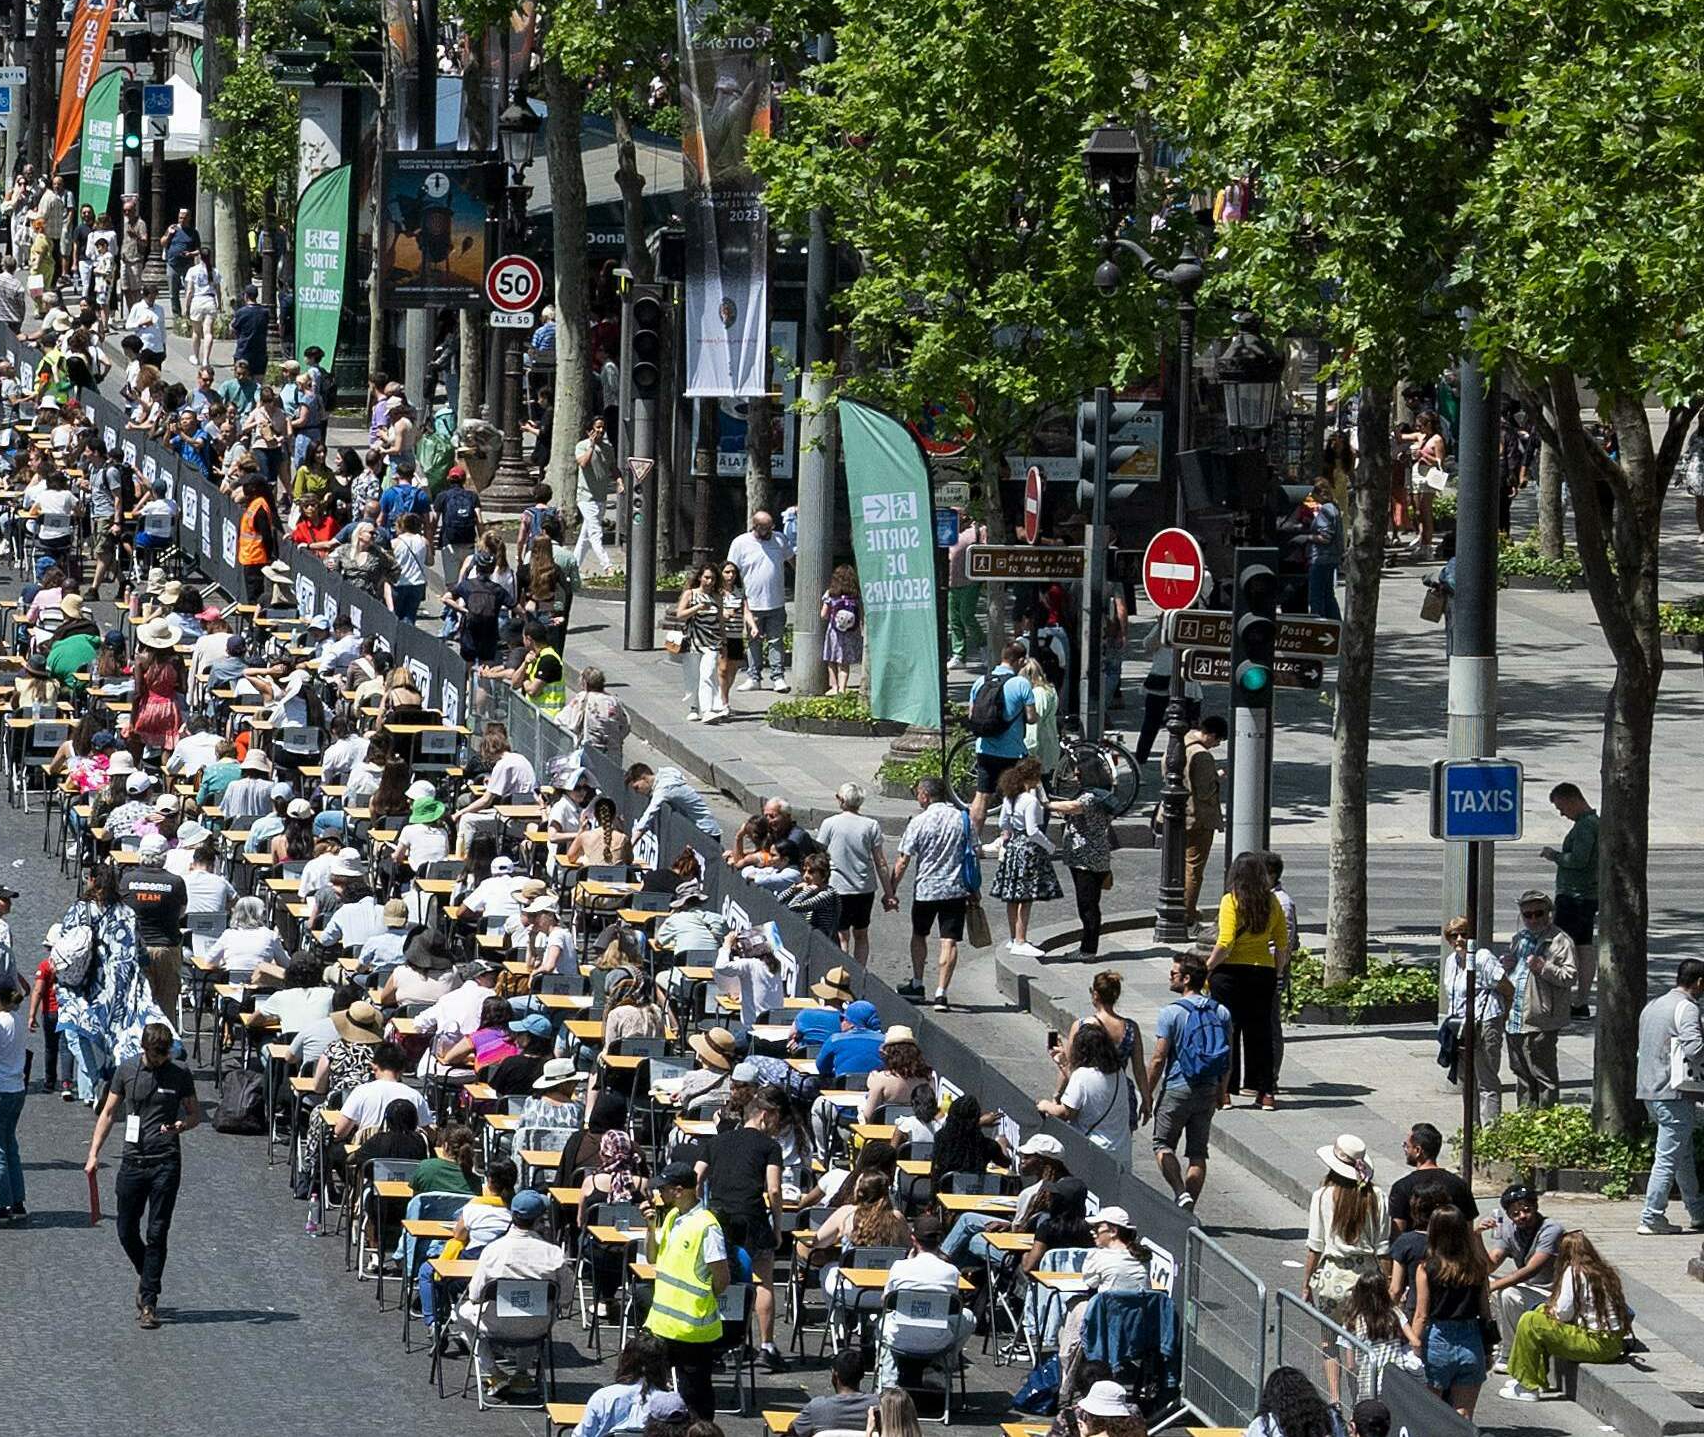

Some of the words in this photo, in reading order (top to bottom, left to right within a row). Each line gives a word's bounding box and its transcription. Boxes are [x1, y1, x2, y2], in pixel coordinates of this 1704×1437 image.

[77, 19, 99, 99] SECOURS
[88, 138, 111, 154] SORTIE
[92, 153, 103, 166] DE
[83, 166, 112, 182] SECOURS
[729, 210, 760, 222] 2023
[304, 252, 339, 270] SORTIE
[312, 270, 327, 287] DE
[500, 273, 531, 296] 50
[298, 288, 340, 305] SECOURS
[494, 312, 512, 324] AXE
[518, 312, 530, 324] 50
[1042, 554, 1053, 563] de
[1024, 565, 1041, 574] Rue
[1280, 625, 1312, 637] Poste
[1450, 790, 1514, 814] TAXIS
[136, 892, 161, 902] TEAM
